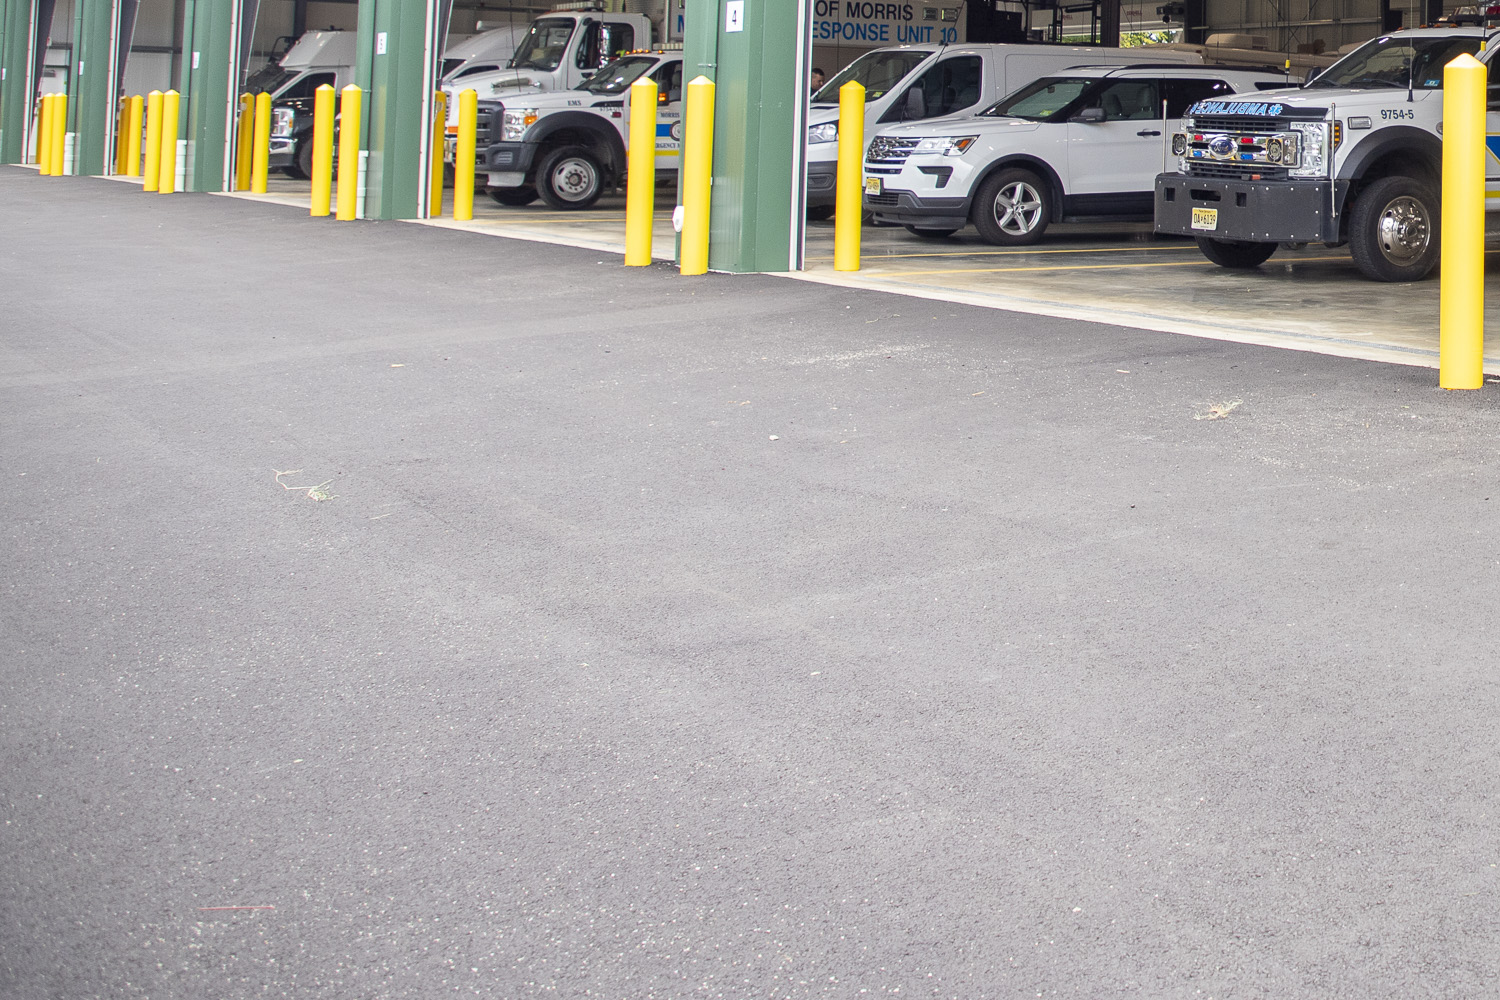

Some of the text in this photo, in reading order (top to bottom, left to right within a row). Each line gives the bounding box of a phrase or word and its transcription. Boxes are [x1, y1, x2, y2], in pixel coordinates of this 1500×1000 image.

[731, 9, 737, 26] 4
[815, 0, 914, 21] OF MORRIS
[812, 20, 957, 43] ESPONSE UNIT 10
[1380, 109, 1414, 120] 9754-5
